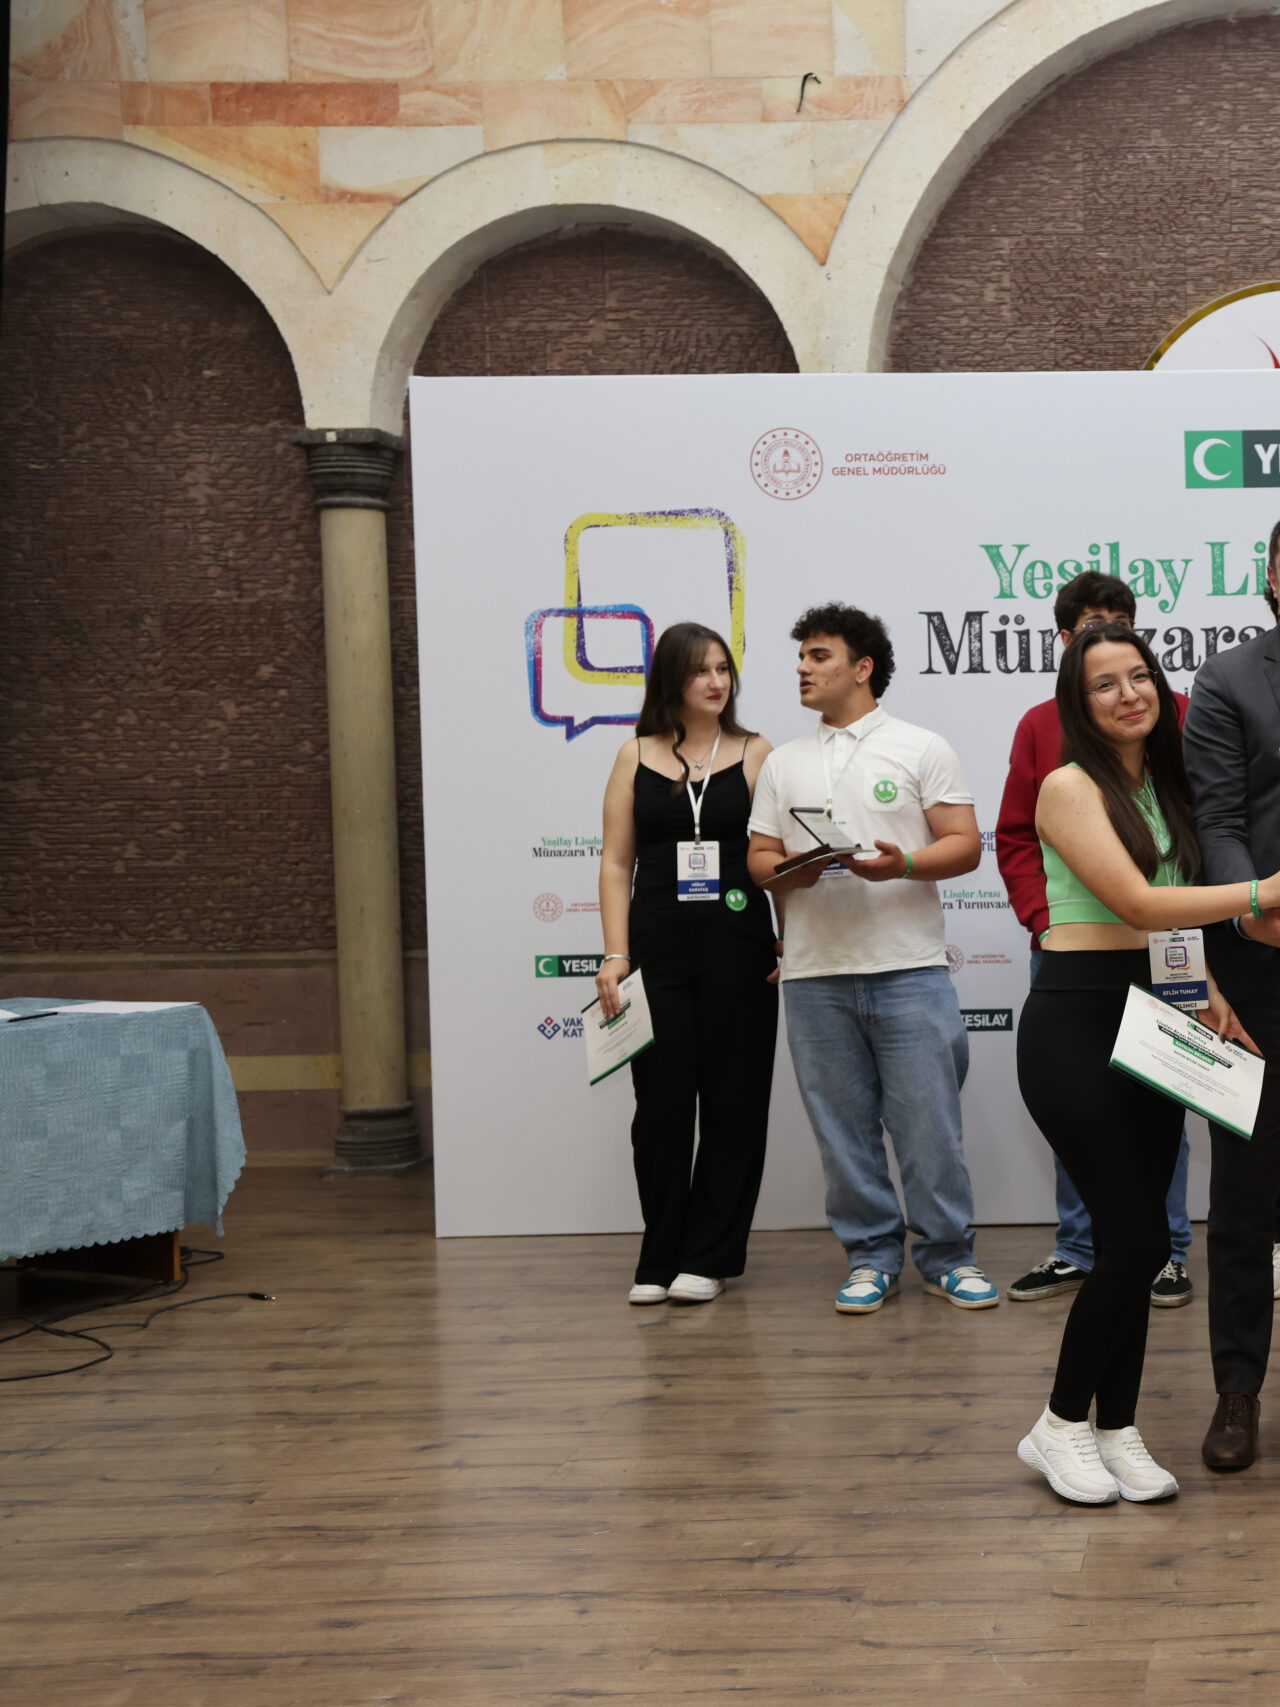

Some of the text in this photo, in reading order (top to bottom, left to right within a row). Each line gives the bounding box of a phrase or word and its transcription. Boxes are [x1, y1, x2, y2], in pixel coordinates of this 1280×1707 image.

[845, 450, 929, 463] ORTAÖĞRETİM
[832, 464, 946, 476] GENEL MÜDÜRLÜĞÜ
